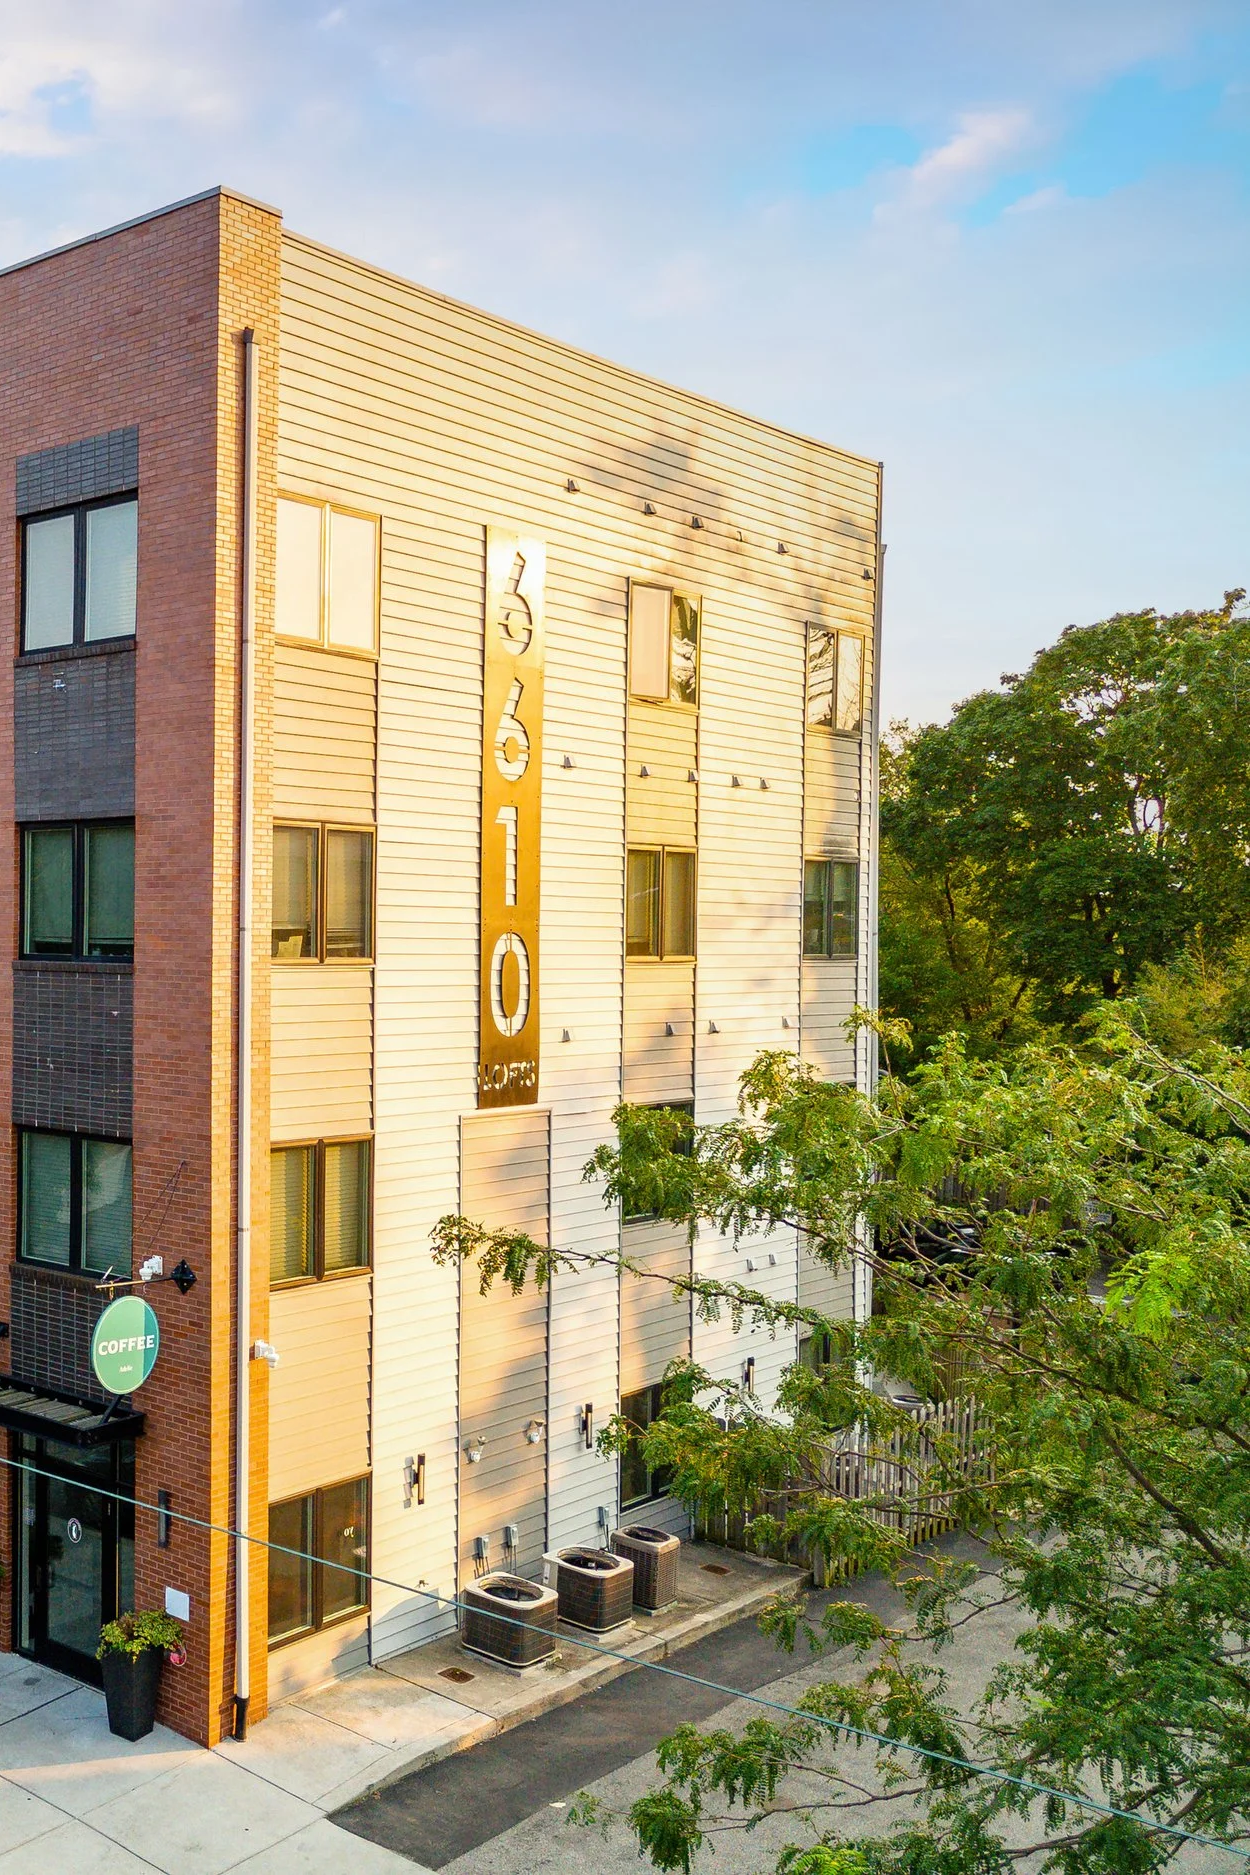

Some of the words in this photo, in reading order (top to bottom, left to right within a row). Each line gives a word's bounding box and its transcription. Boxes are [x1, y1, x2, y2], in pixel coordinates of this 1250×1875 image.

[491, 551, 533, 1038] 6610
[483, 1060, 536, 1091] LOFTS
[98, 1334, 155, 1356] COFFEE
